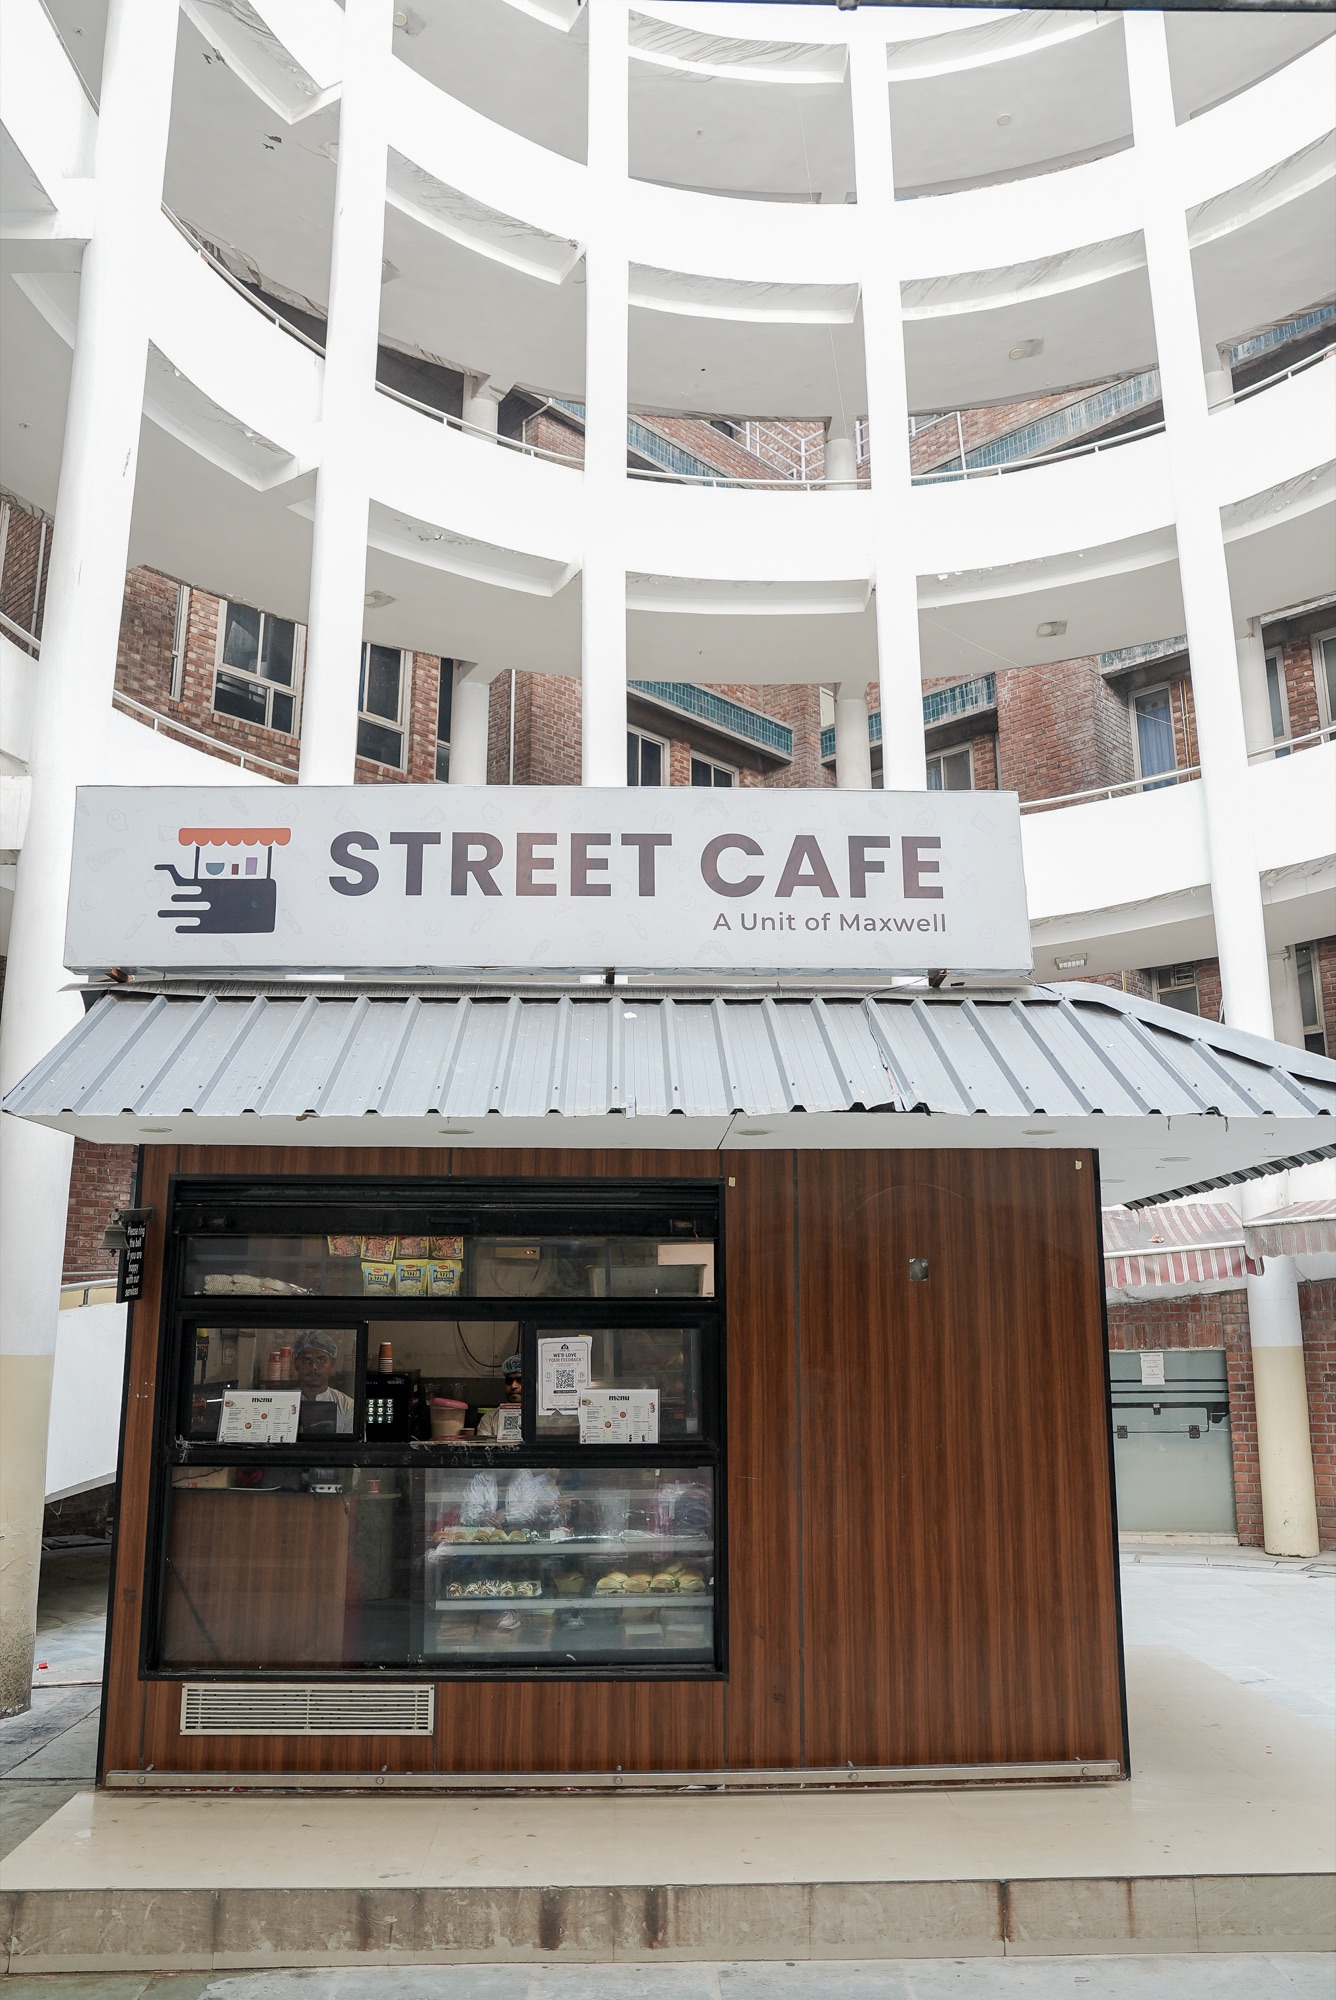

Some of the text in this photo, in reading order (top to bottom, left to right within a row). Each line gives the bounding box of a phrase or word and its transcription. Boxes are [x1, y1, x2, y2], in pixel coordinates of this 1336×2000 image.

[328, 830, 944, 899] STREET CAFE
[712, 911, 946, 932] A Unit of Maxwell
